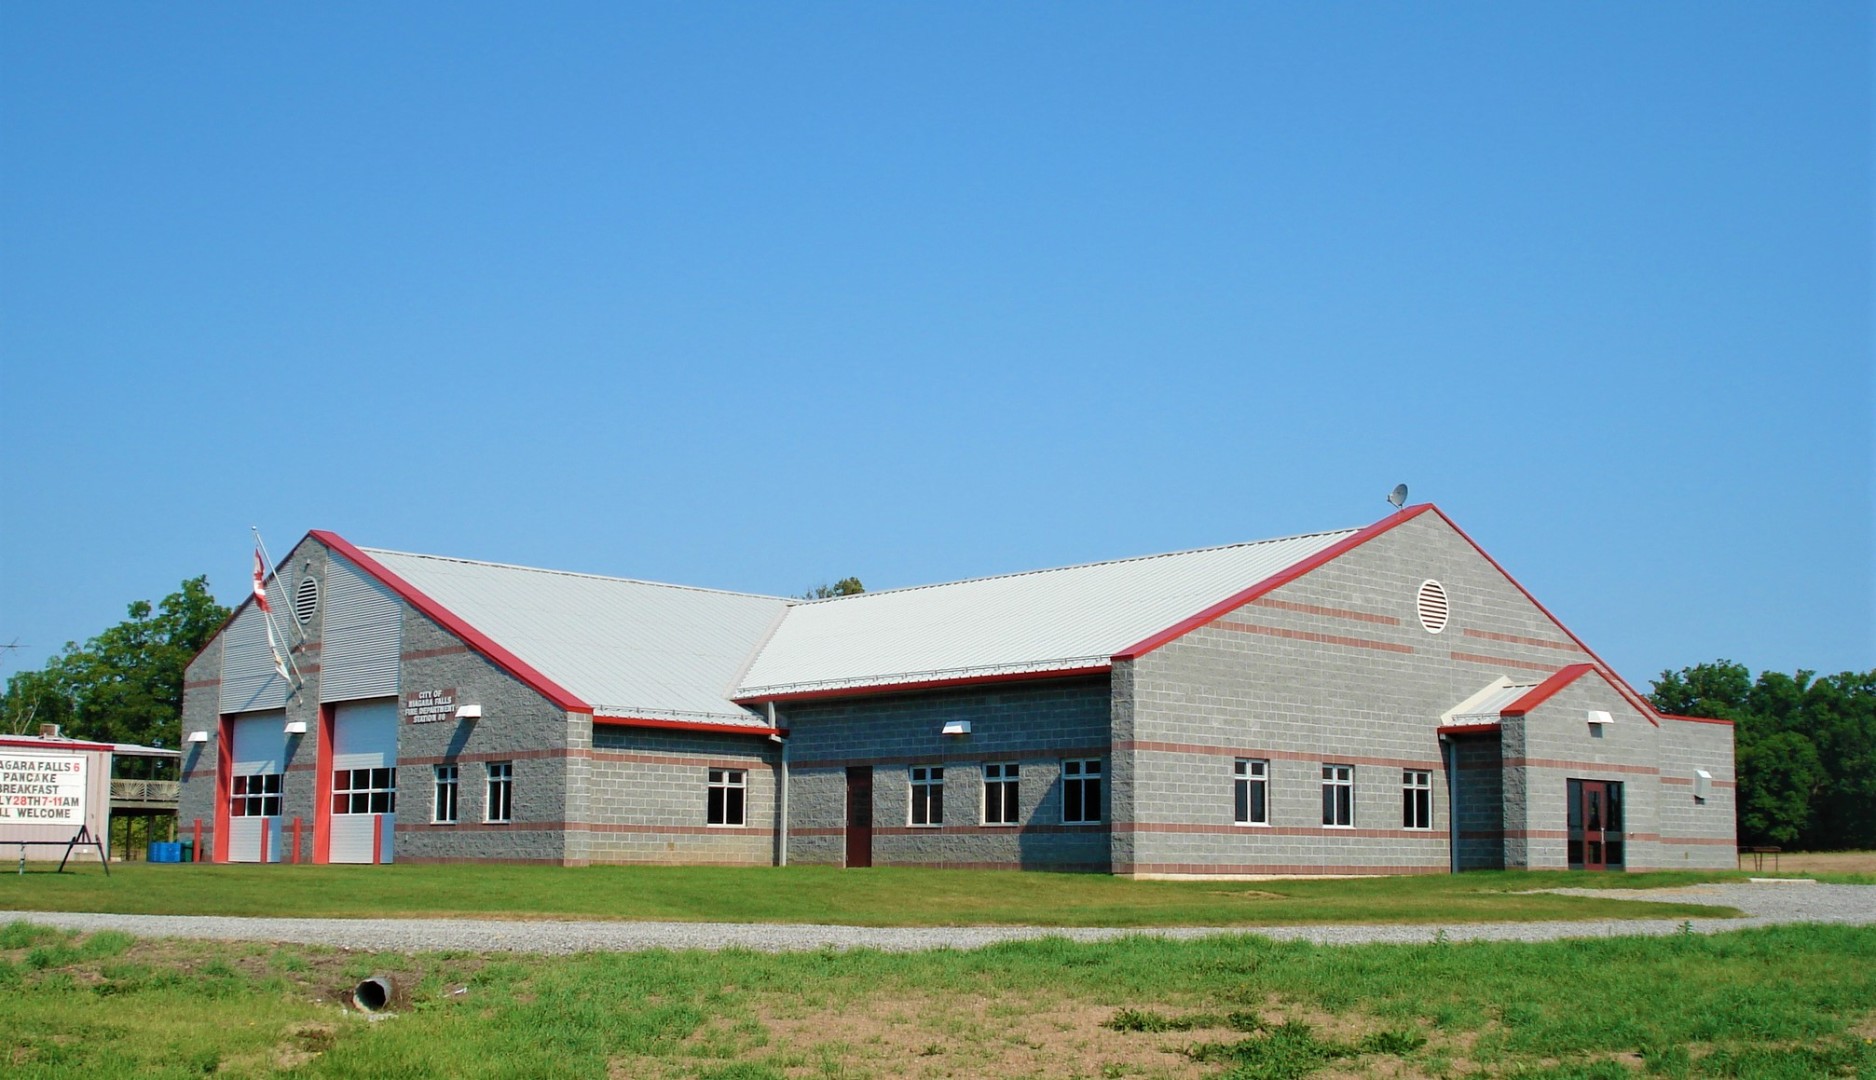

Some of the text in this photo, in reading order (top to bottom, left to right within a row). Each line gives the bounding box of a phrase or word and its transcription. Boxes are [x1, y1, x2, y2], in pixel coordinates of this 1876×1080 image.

[433, 690, 442, 698] OF
[434, 696, 452, 705] FALLS
[38, 761, 71, 772] FALLS
[73, 763, 80, 772] 6
[3, 773, 57, 783] PANCAKE
[17, 808, 71, 819] WELCOME
